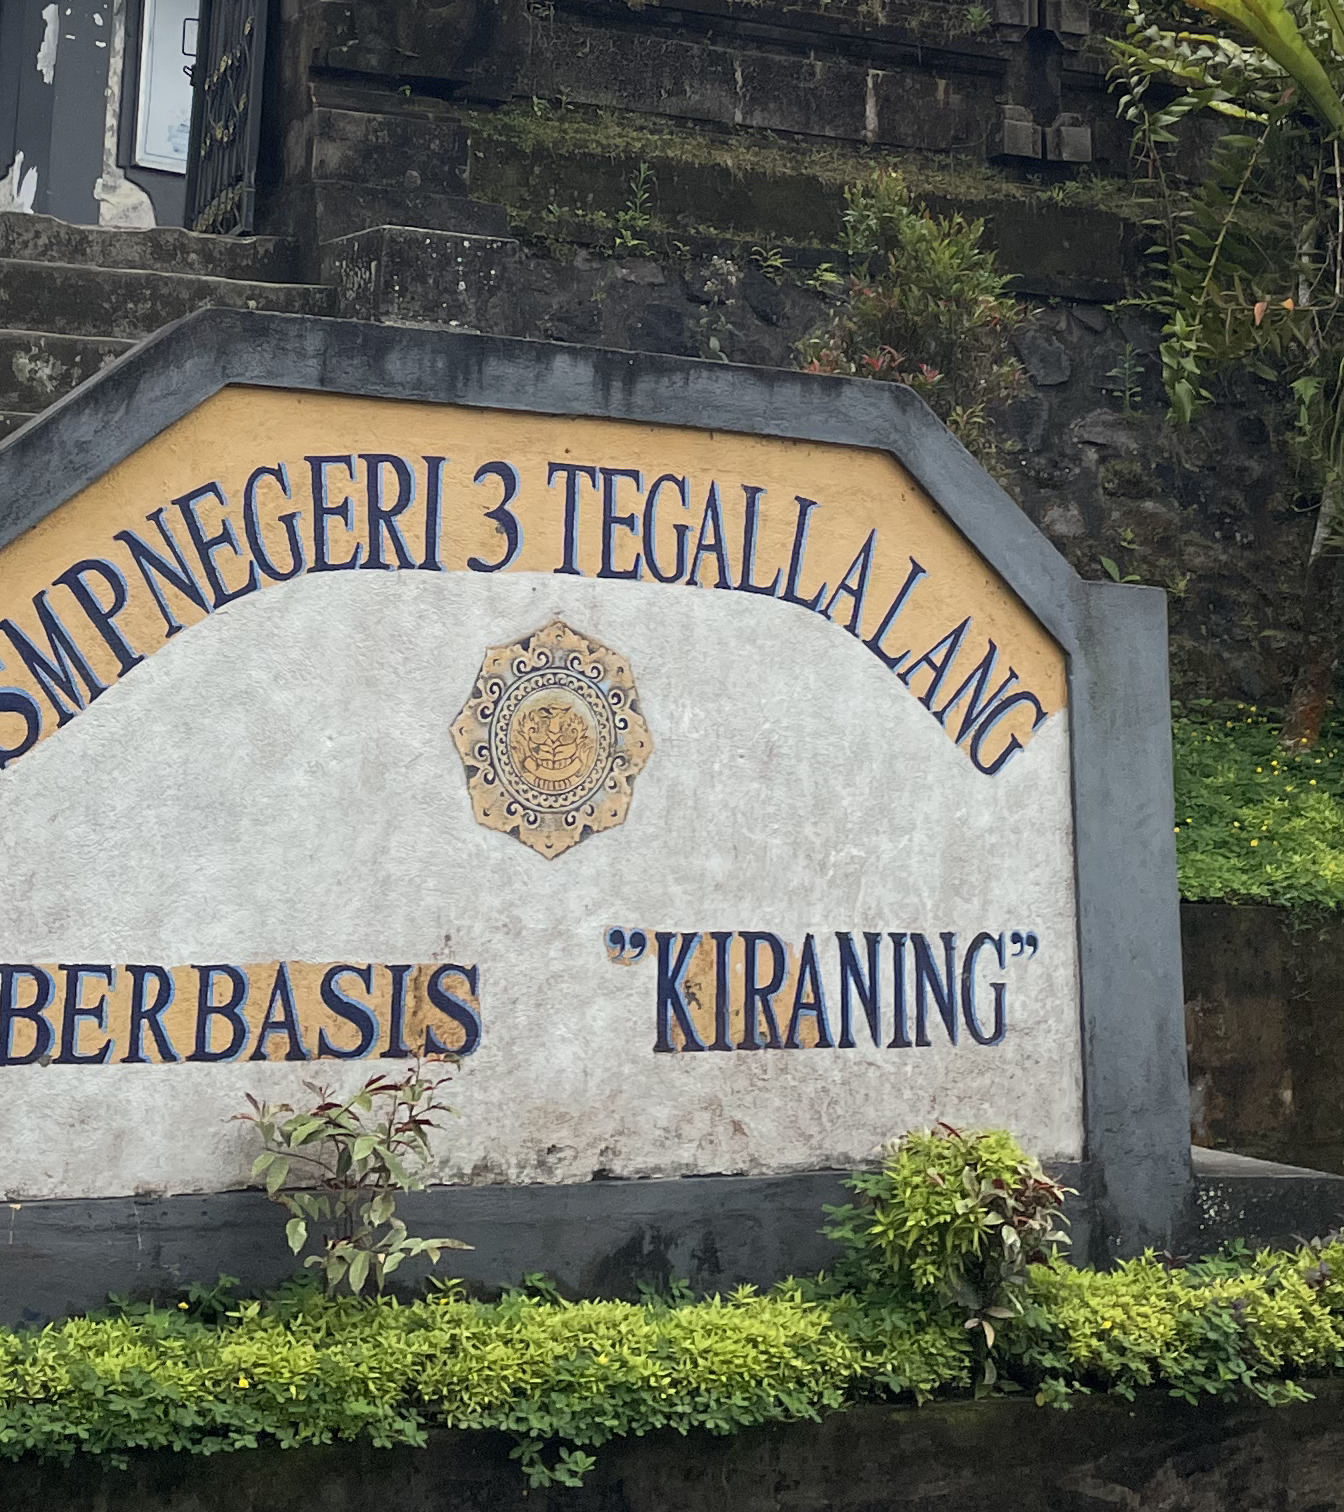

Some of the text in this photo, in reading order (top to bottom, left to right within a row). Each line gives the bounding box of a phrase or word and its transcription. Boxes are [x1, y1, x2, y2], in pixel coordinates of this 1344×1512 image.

[113, 453, 447, 638] NEGERI
[467, 460, 524, 573] 3
[548, 461, 1049, 777] TEGALLALANG
